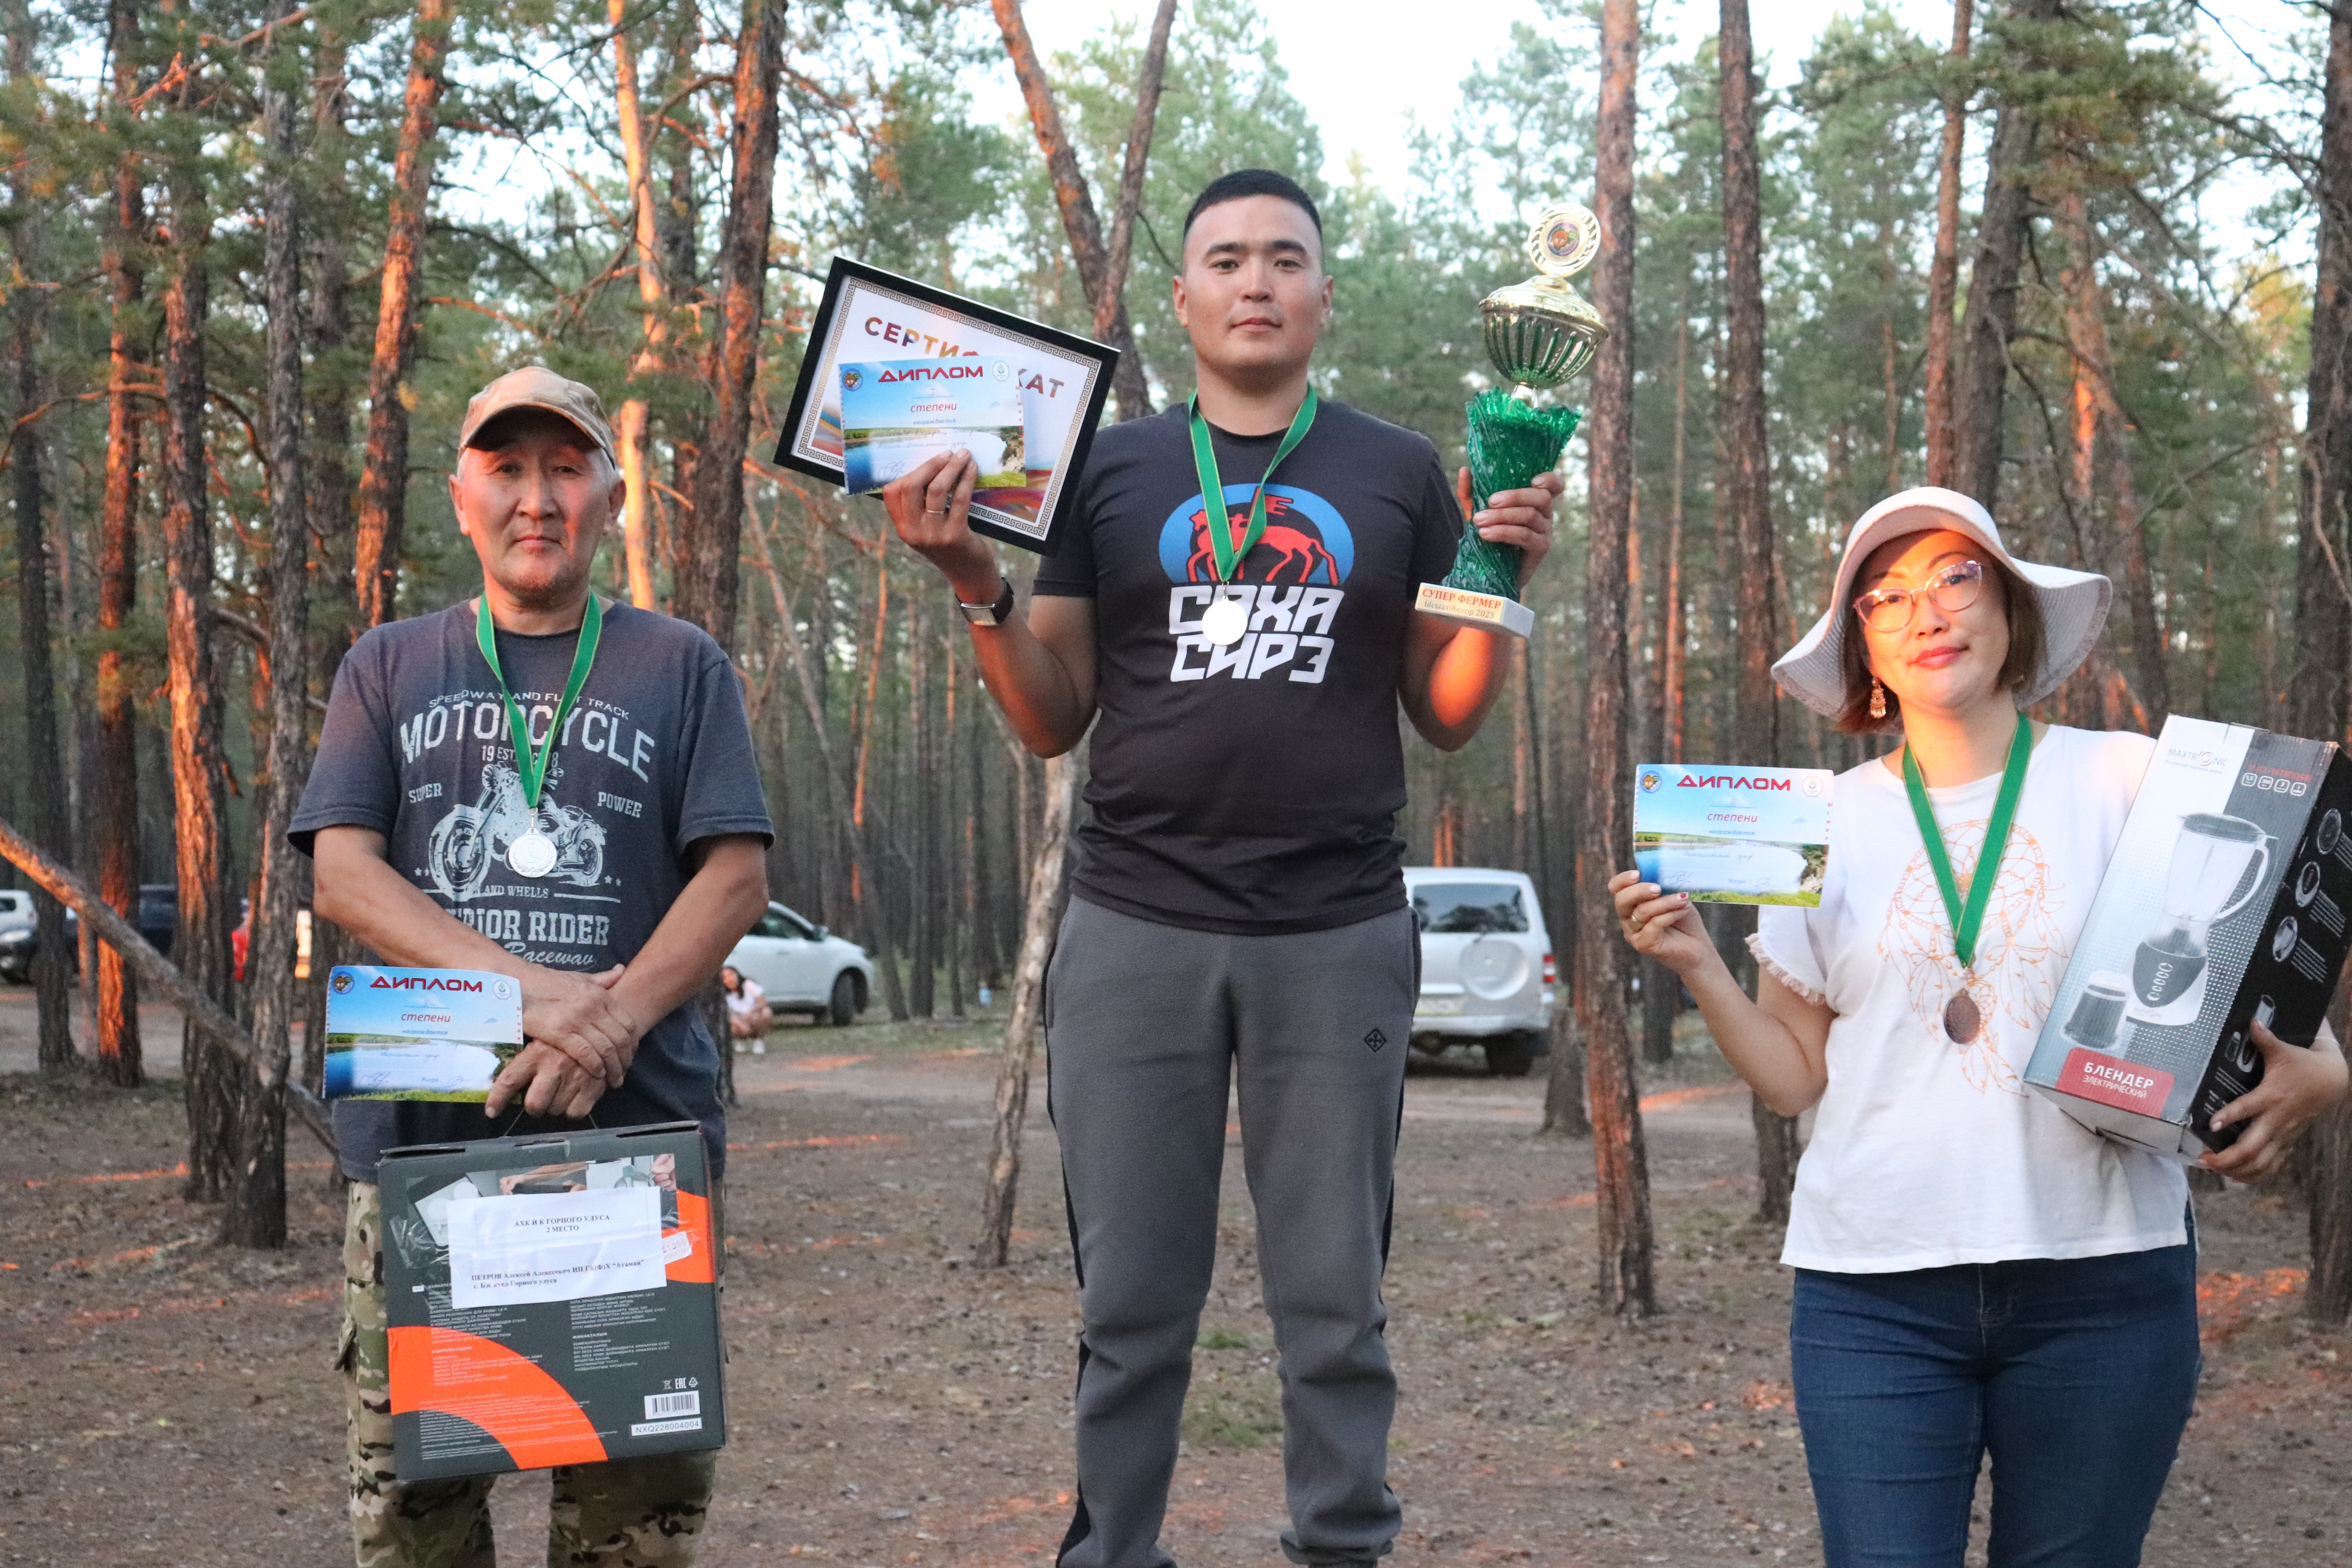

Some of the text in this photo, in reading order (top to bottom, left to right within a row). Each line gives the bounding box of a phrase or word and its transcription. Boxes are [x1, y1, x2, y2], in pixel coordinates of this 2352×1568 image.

[865, 317, 1064, 398] СЕРТИАТ
[878, 366, 983, 383] ДИПЛОМ
[910, 402, 957, 413] степени
[1423, 588, 1501, 609] СУПЕР ФЕРМЕР
[1425, 601, 1494, 619] Ысыах Аккор 2023
[429, 690, 629, 720] SPEEDWAY AND FLT TRACK
[482, 745, 495, 762] 19
[2168, 748, 2229, 767] MAXTRONIC
[1677, 775, 1791, 791] ДИПЛОМ
[408, 783, 442, 804] SUPER
[598, 791, 642, 818] POWER
[1708, 813, 1758, 823] степени
[508, 886, 549, 898] WHELLS
[528, 911, 610, 946] RIDER
[370, 976, 482, 992] ДИПЛОМ
[401, 1013, 451, 1023] степени
[2084, 1062, 2154, 1089] БЛЕНДЕР
[2083, 1075, 2147, 1099] ЭЛЕКТРИЧЕСКИЙ
[546, 1216, 583, 1225] ГОРНОГО
[532, 1268, 571, 1277] Алексеевич
[511, 1279, 537, 1288] Горного
[539, 1278, 557, 1286] улуса
[675, 1377, 687, 1390] EAC
[636, 1421, 699, 1434] NXQ228004004
